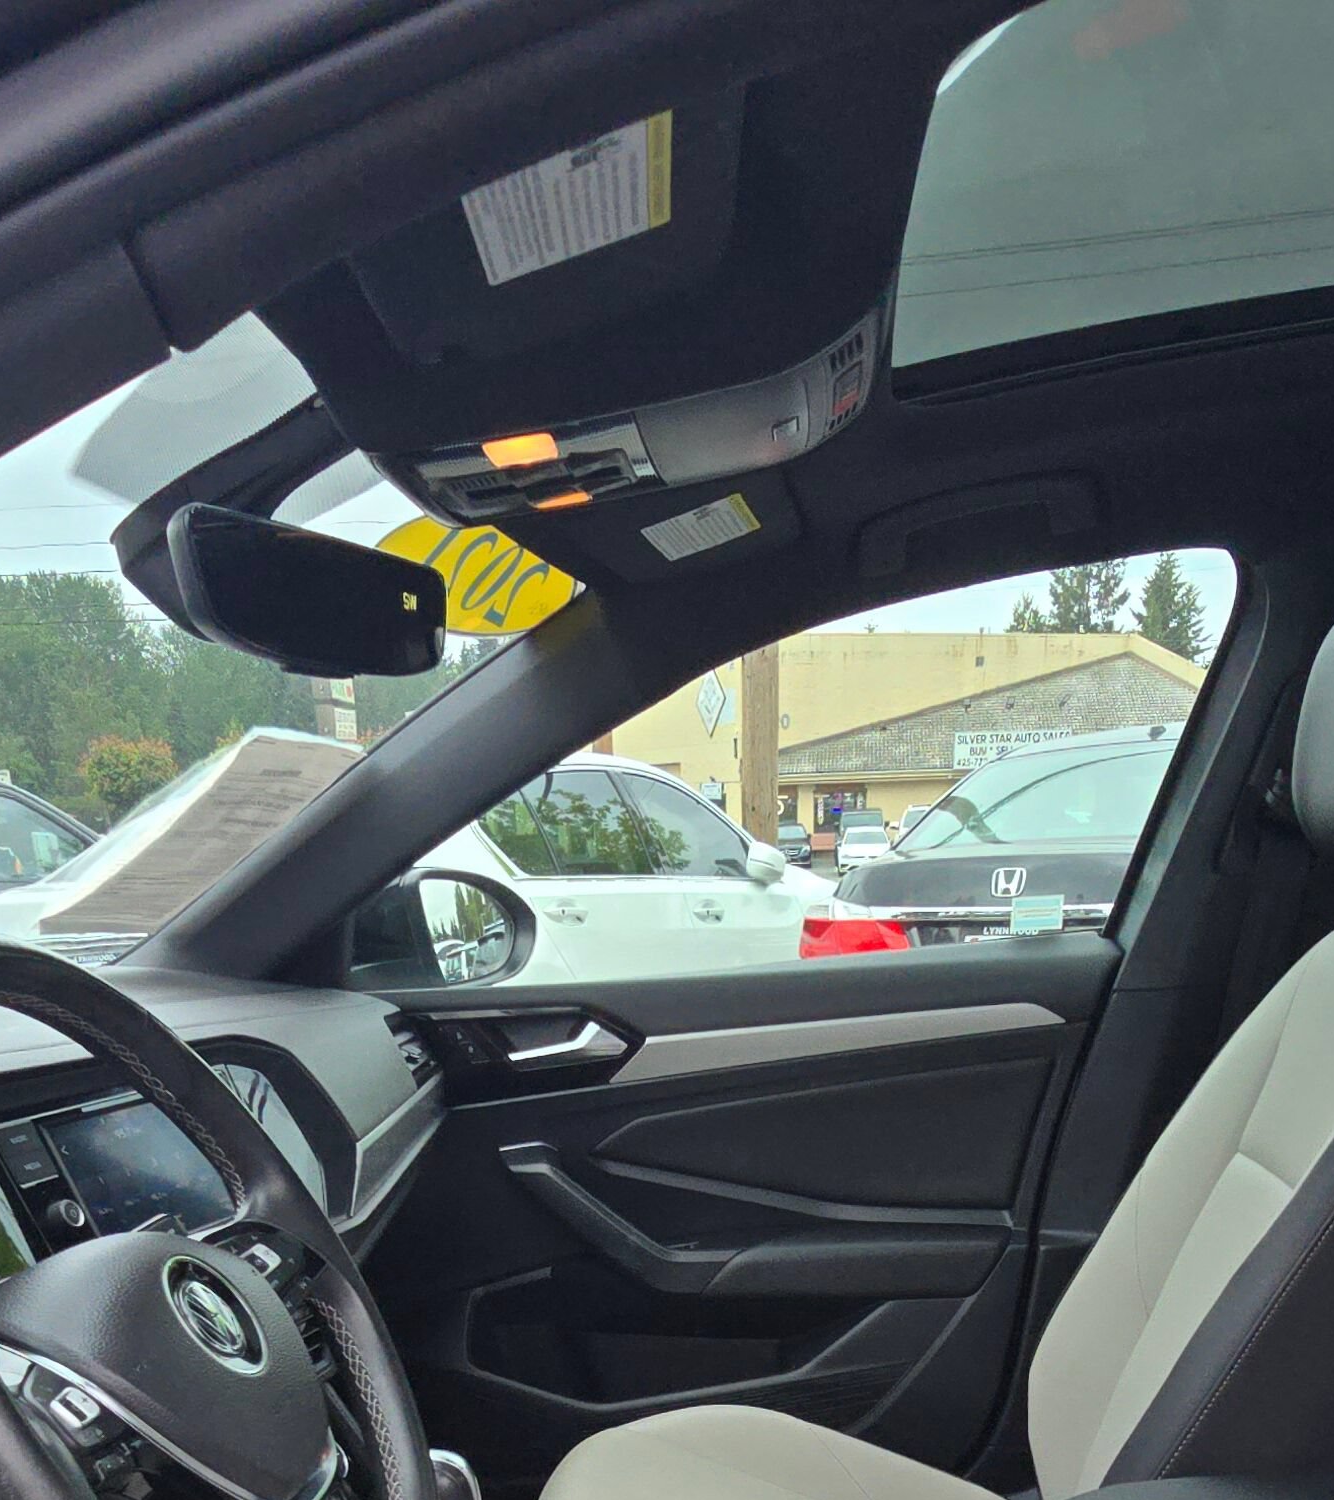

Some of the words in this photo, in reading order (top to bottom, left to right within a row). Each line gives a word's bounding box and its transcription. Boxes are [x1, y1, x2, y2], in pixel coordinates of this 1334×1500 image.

[956, 734, 987, 746] SILVER
[989, 733, 1012, 745] STAR
[1014, 732, 1041, 744] AUTO
